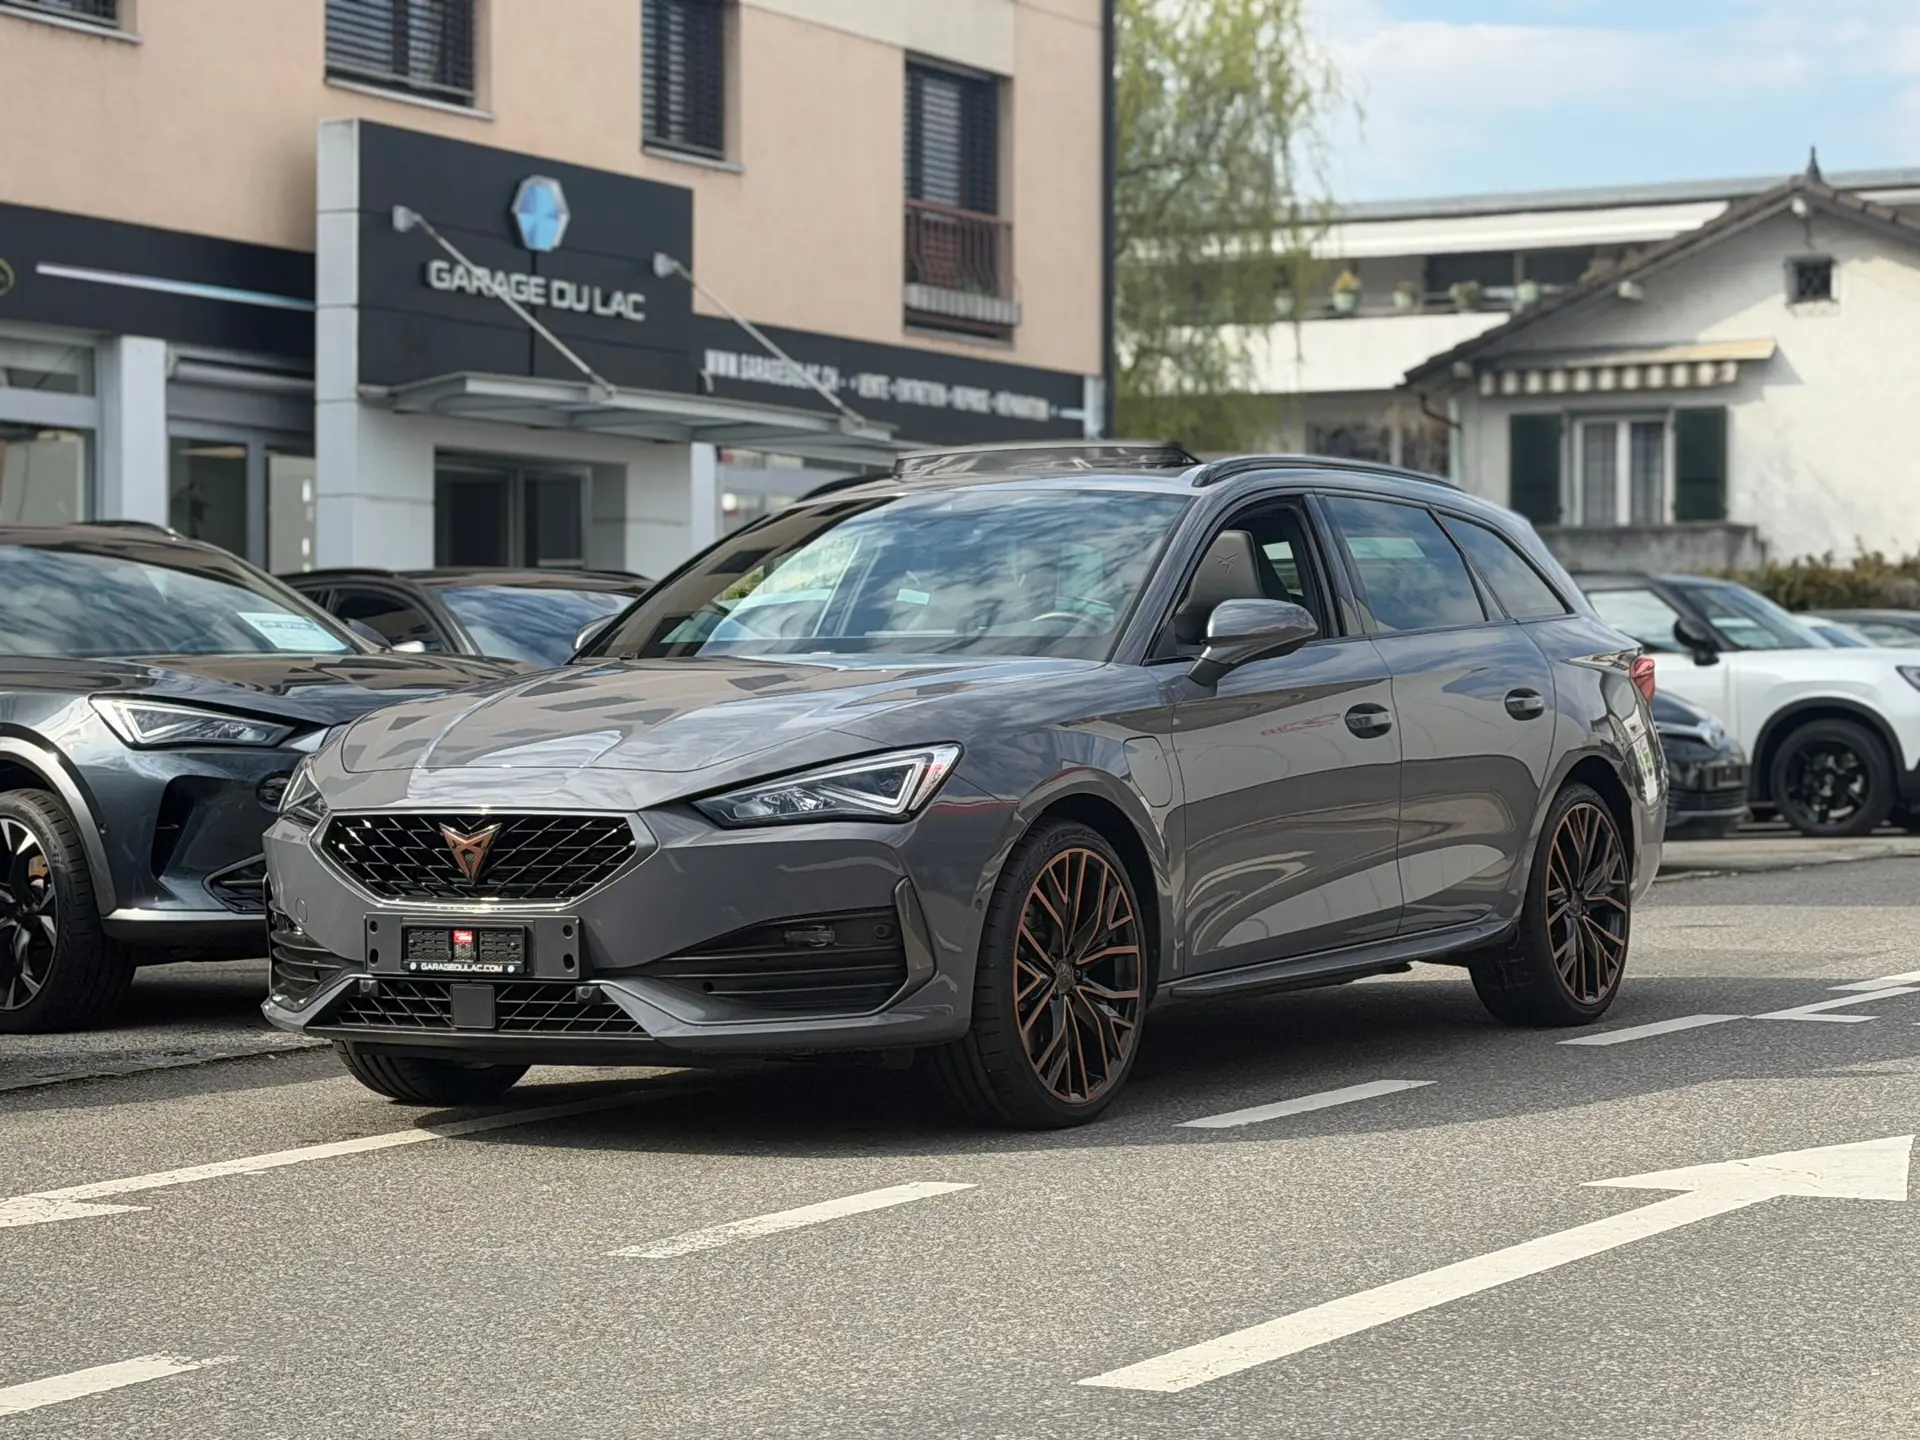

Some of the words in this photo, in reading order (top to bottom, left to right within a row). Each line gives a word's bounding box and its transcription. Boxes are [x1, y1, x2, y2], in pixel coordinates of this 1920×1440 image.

[428, 259, 547, 305] GARAGE
[550, 279, 589, 312] DU
[593, 287, 646, 322] LAC
[420, 962, 504, 973] GARAGEDULAC.COM
